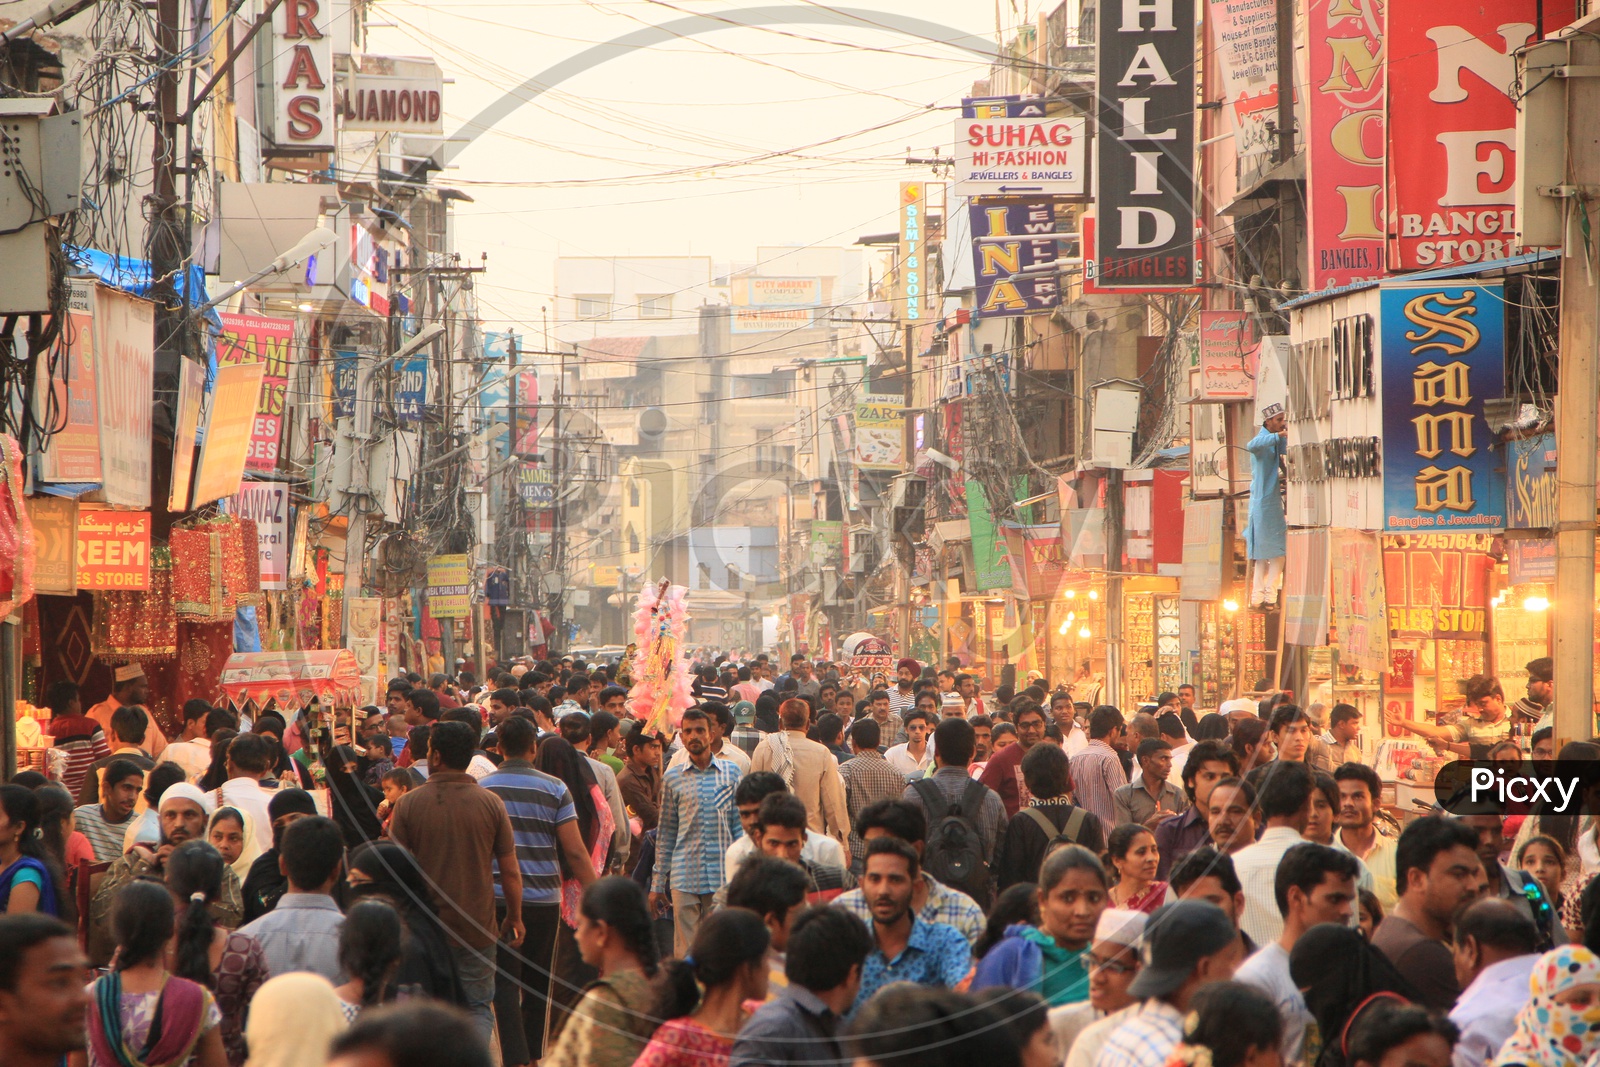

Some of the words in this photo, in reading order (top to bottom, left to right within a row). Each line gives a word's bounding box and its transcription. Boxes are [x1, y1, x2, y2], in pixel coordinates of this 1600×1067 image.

[1226, 0, 1274, 14] Manufacturers
[1232, 17, 1239, 26] &
[1222, 31, 1243, 42] House
[1243, 28, 1251, 37] of
[1233, 42, 1252, 53] Stone
[1232, 65, 1263, 80] Jewellery
[1116, 0, 1178, 250] HALID
[967, 123, 1073, 147] SUHAG
[968, 171, 1019, 181] JEWELLERS
[1021, 172, 1028, 180] &
[1031, 171, 1073, 180] BANGLES
[905, 204, 919, 254] SAMI
[1104, 256, 1187, 278] BANGLES
[906, 271, 919, 320] SONS
[230, 489, 283, 523] NAWAZ
[1388, 516, 1435, 529] Bangles
[1437, 515, 1446, 526] &
[1447, 514, 1502, 527] Jewellery
[96, 572, 143, 586] STORE
